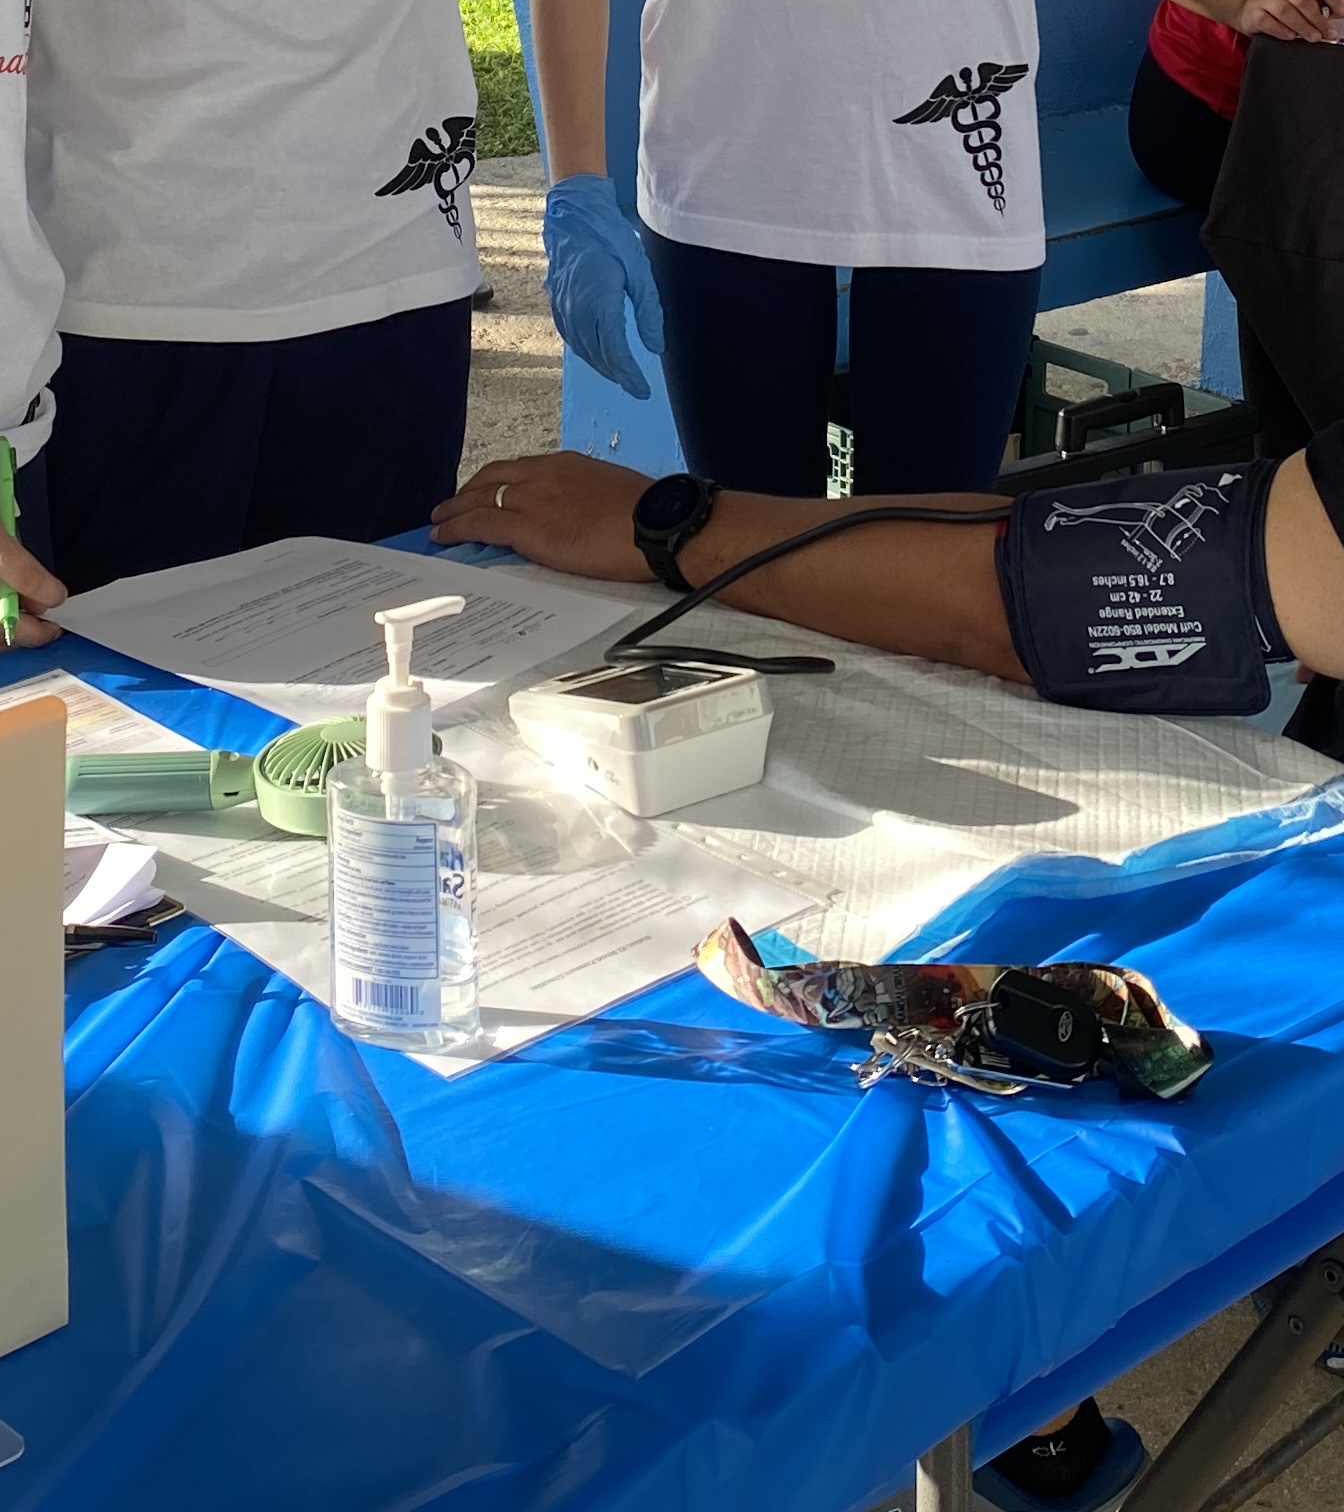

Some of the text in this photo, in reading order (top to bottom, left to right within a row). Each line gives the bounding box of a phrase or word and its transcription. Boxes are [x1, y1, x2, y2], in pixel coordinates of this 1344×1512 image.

[1092, 575, 1127, 588] inches
[1129, 574, 1150, 587] 16.5
[1159, 572, 1175, 586] 8.7
[1109, 592, 1126, 603] cm
[1128, 591, 1141, 603] 42
[1149, 589, 1163, 602] 22
[1098, 606, 1185, 620] Extended Range
[1144, 623, 1178, 635] Model
[1180, 621, 1203, 634] Cuff
